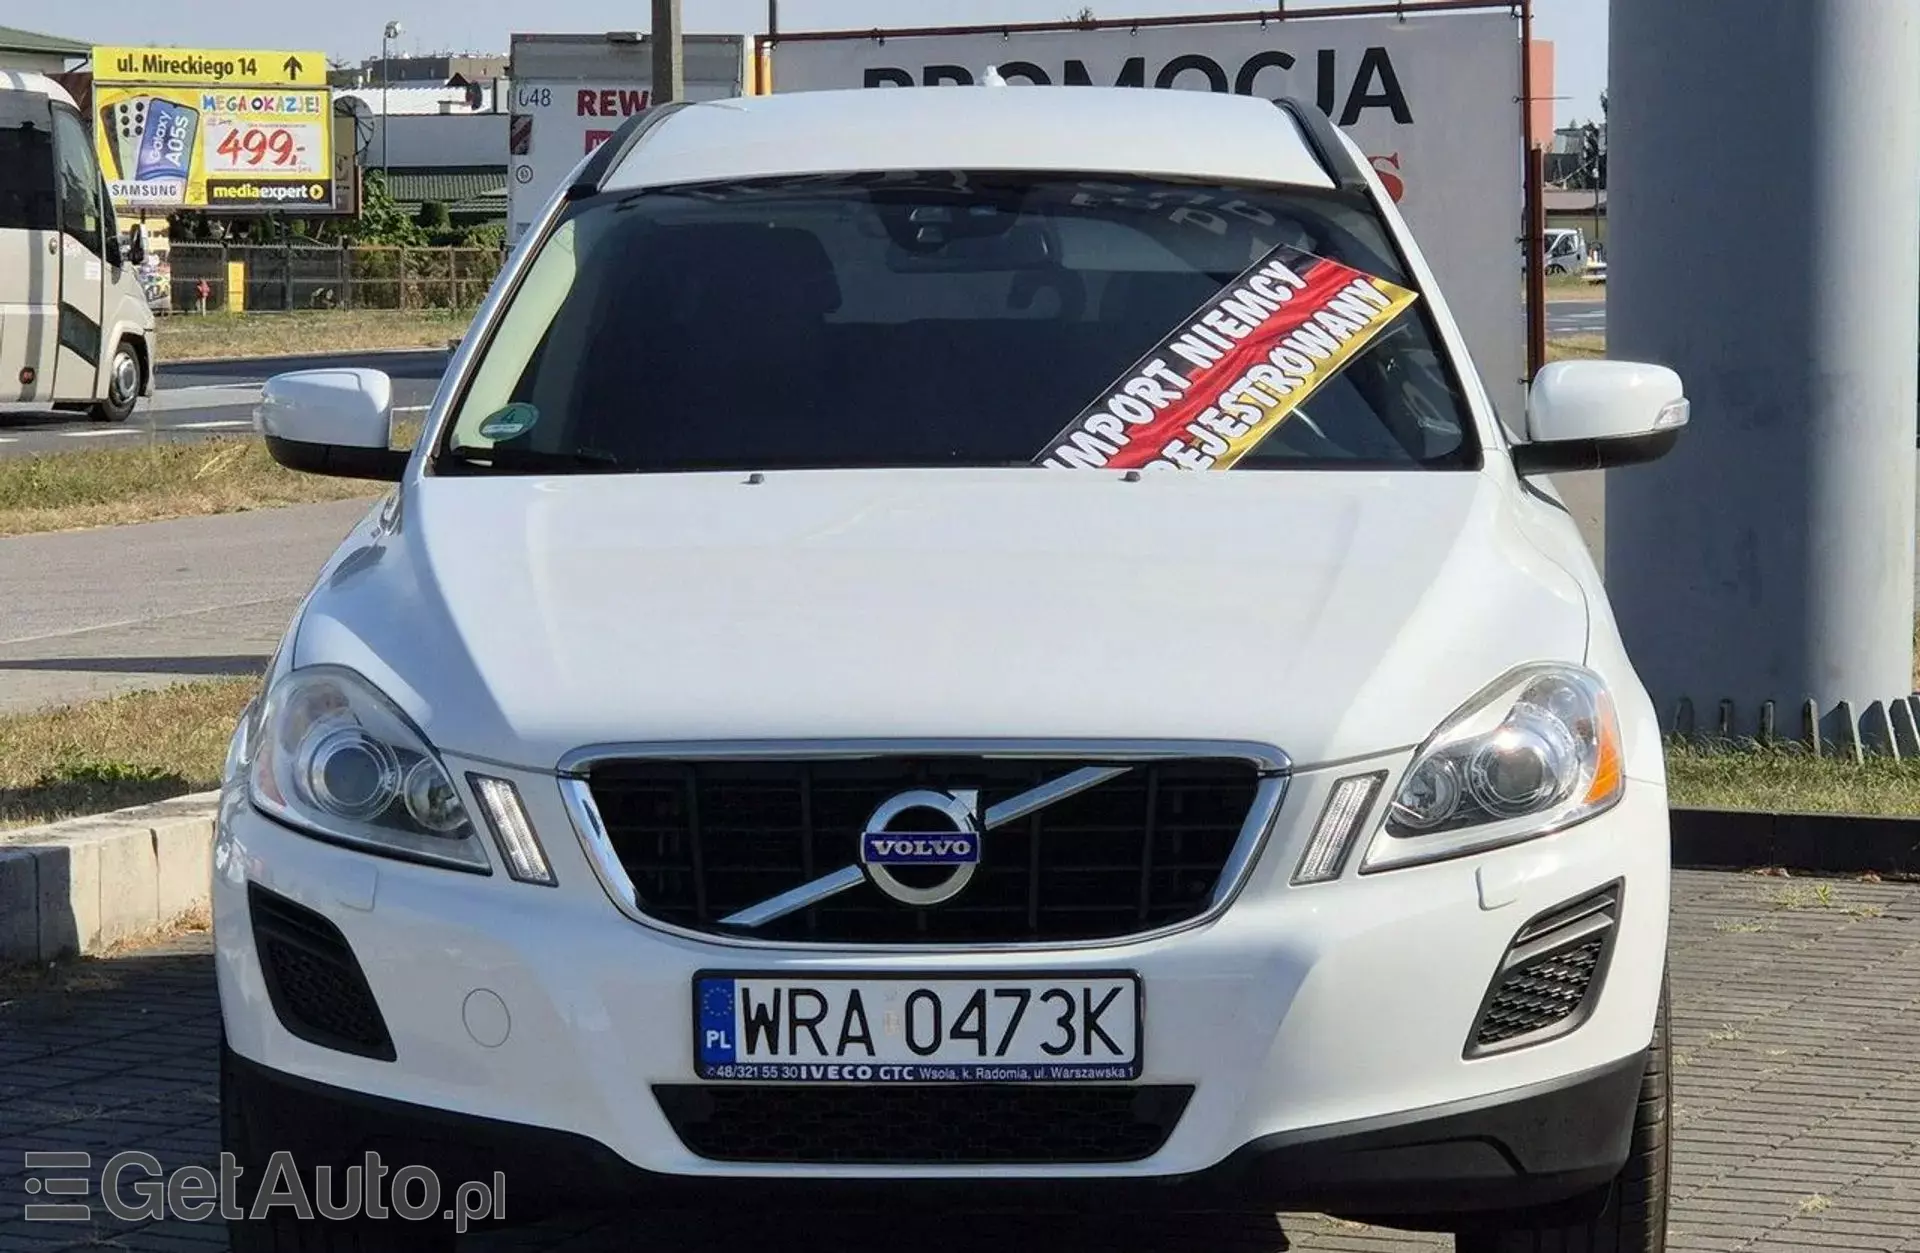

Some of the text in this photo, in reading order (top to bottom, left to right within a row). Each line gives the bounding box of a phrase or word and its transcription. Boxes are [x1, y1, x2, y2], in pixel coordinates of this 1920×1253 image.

[117, 53, 257, 80] ul. Mireckiego 14
[863, 46, 1414, 126] OCJA
[203, 94, 320, 113] MEGA OKAZJE!
[578, 90, 652, 117] REW
[150, 110, 172, 164] Galaxy
[112, 184, 177, 197] SAMSUNG
[213, 183, 308, 201] mediaexpert
[1170, 260, 1308, 369] NIEMCY
[1143, 277, 1393, 470] EJESTROWANY
[870, 840, 971, 855] VOLVO
[742, 987, 1124, 1057] WRA 0473K
[706, 1031, 732, 1050] PL
[762, 1066, 778, 1078] 55
[781, 1066, 798, 1078] 30
[800, 1066, 873, 1079] IVECO
[962, 1067, 973, 1079] k.
[976, 1067, 1032, 1080] Radomia,
[1034, 1067, 1046, 1079] ul.
[1050, 1067, 1126, 1079] Warszawska
[1128, 1067, 1135, 1077] 1
